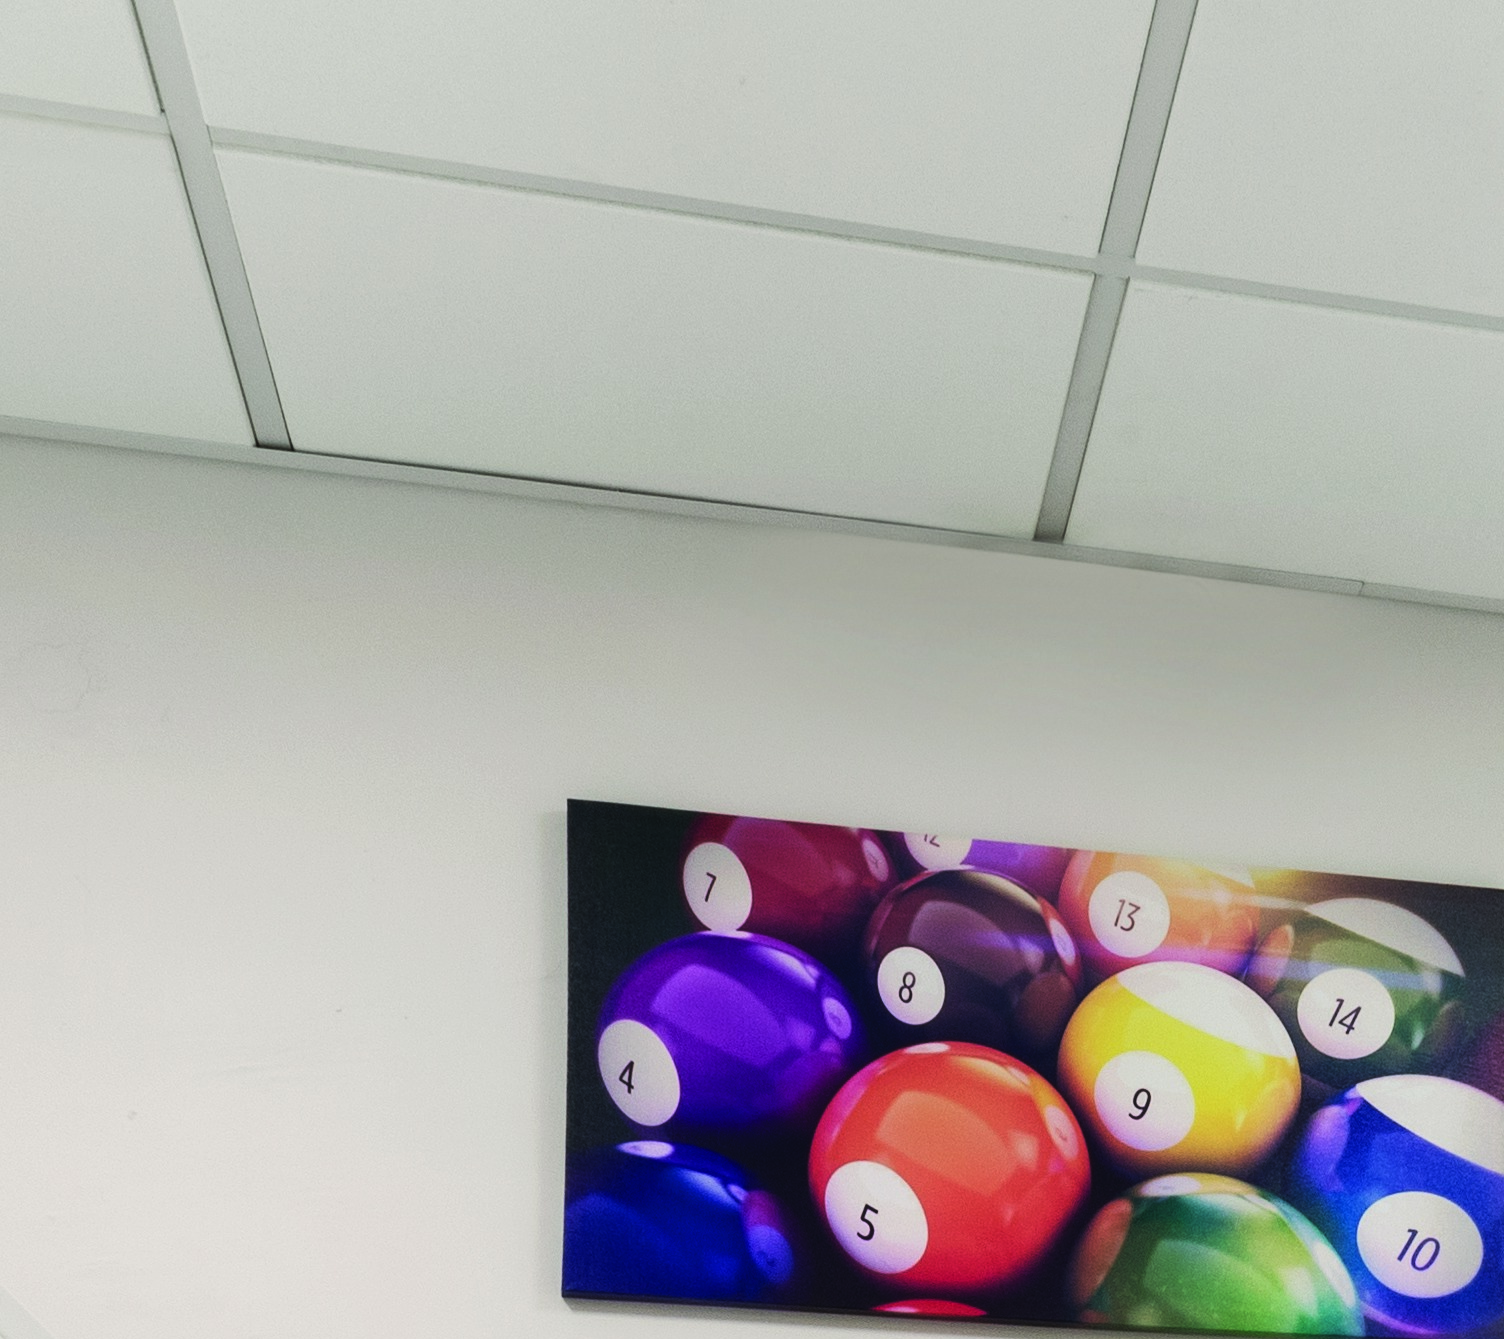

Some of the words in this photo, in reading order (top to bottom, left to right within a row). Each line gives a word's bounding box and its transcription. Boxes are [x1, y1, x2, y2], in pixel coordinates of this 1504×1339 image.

[705, 872, 716, 902] 7
[1114, 900, 1140, 931] 13
[899, 972, 915, 1003] 8
[1329, 999, 1361, 1034] 14
[619, 1061, 634, 1094] 4
[1129, 1089, 1151, 1120] 9
[856, 1204, 879, 1241] 5
[1398, 1229, 1440, 1271] 10
